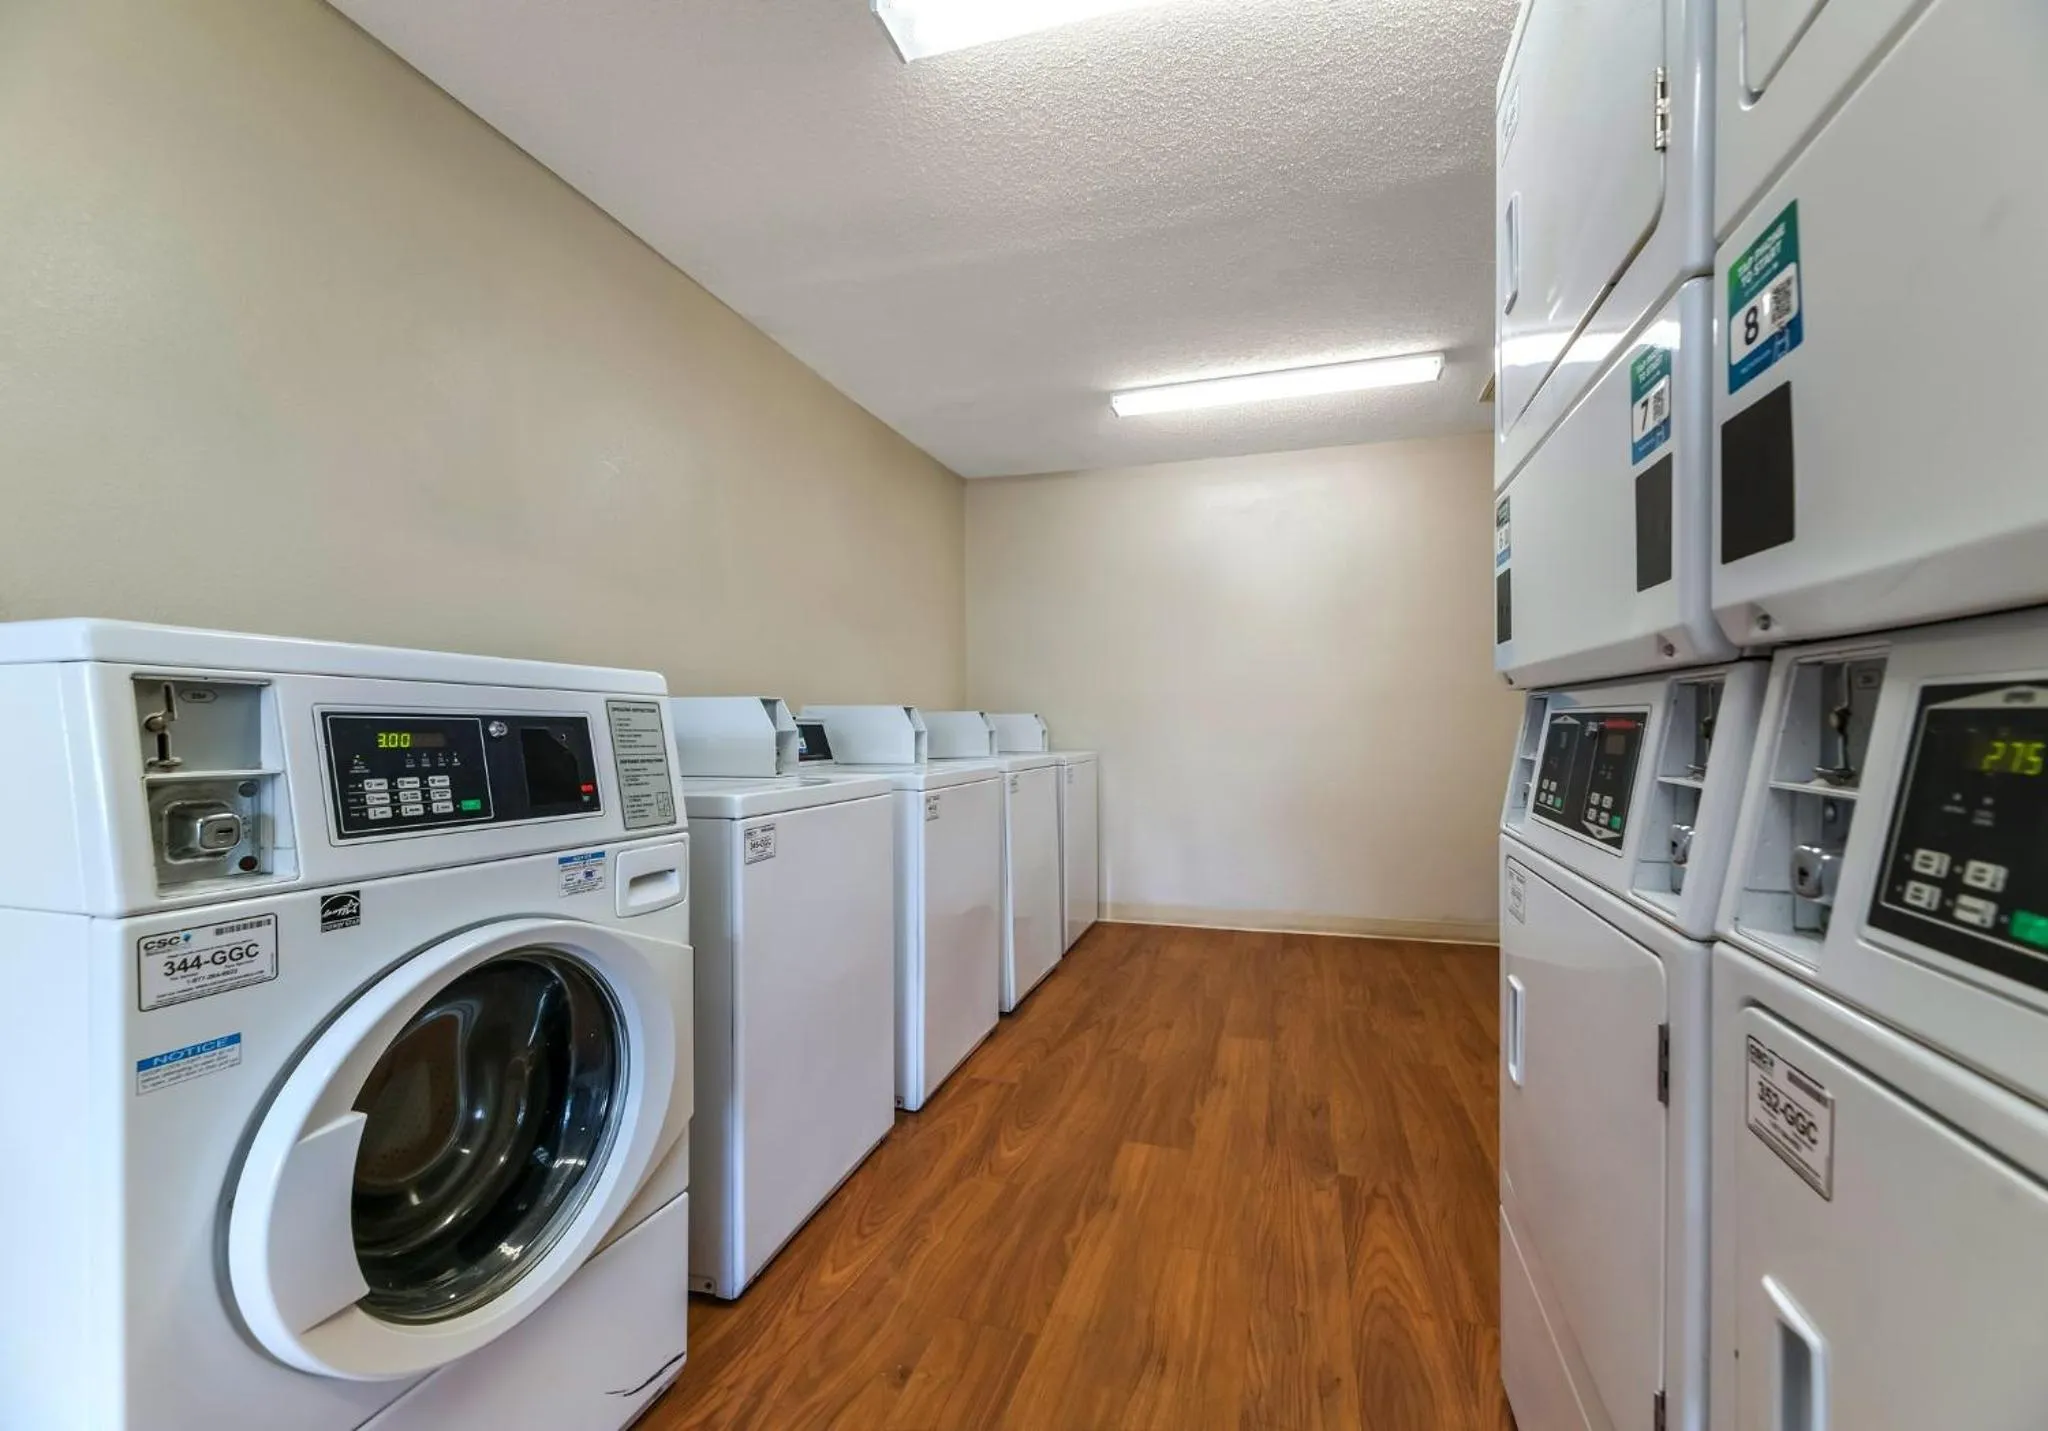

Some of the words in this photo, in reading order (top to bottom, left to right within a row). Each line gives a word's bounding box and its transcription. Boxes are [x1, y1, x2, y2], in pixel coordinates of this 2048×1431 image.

[1744, 305, 1760, 346] 8
[1641, 397, 1649, 432] 7
[143, 935, 181, 952] CSC
[163, 942, 260, 977] 344-GGC
[152, 1037, 228, 1067] NOTICE
